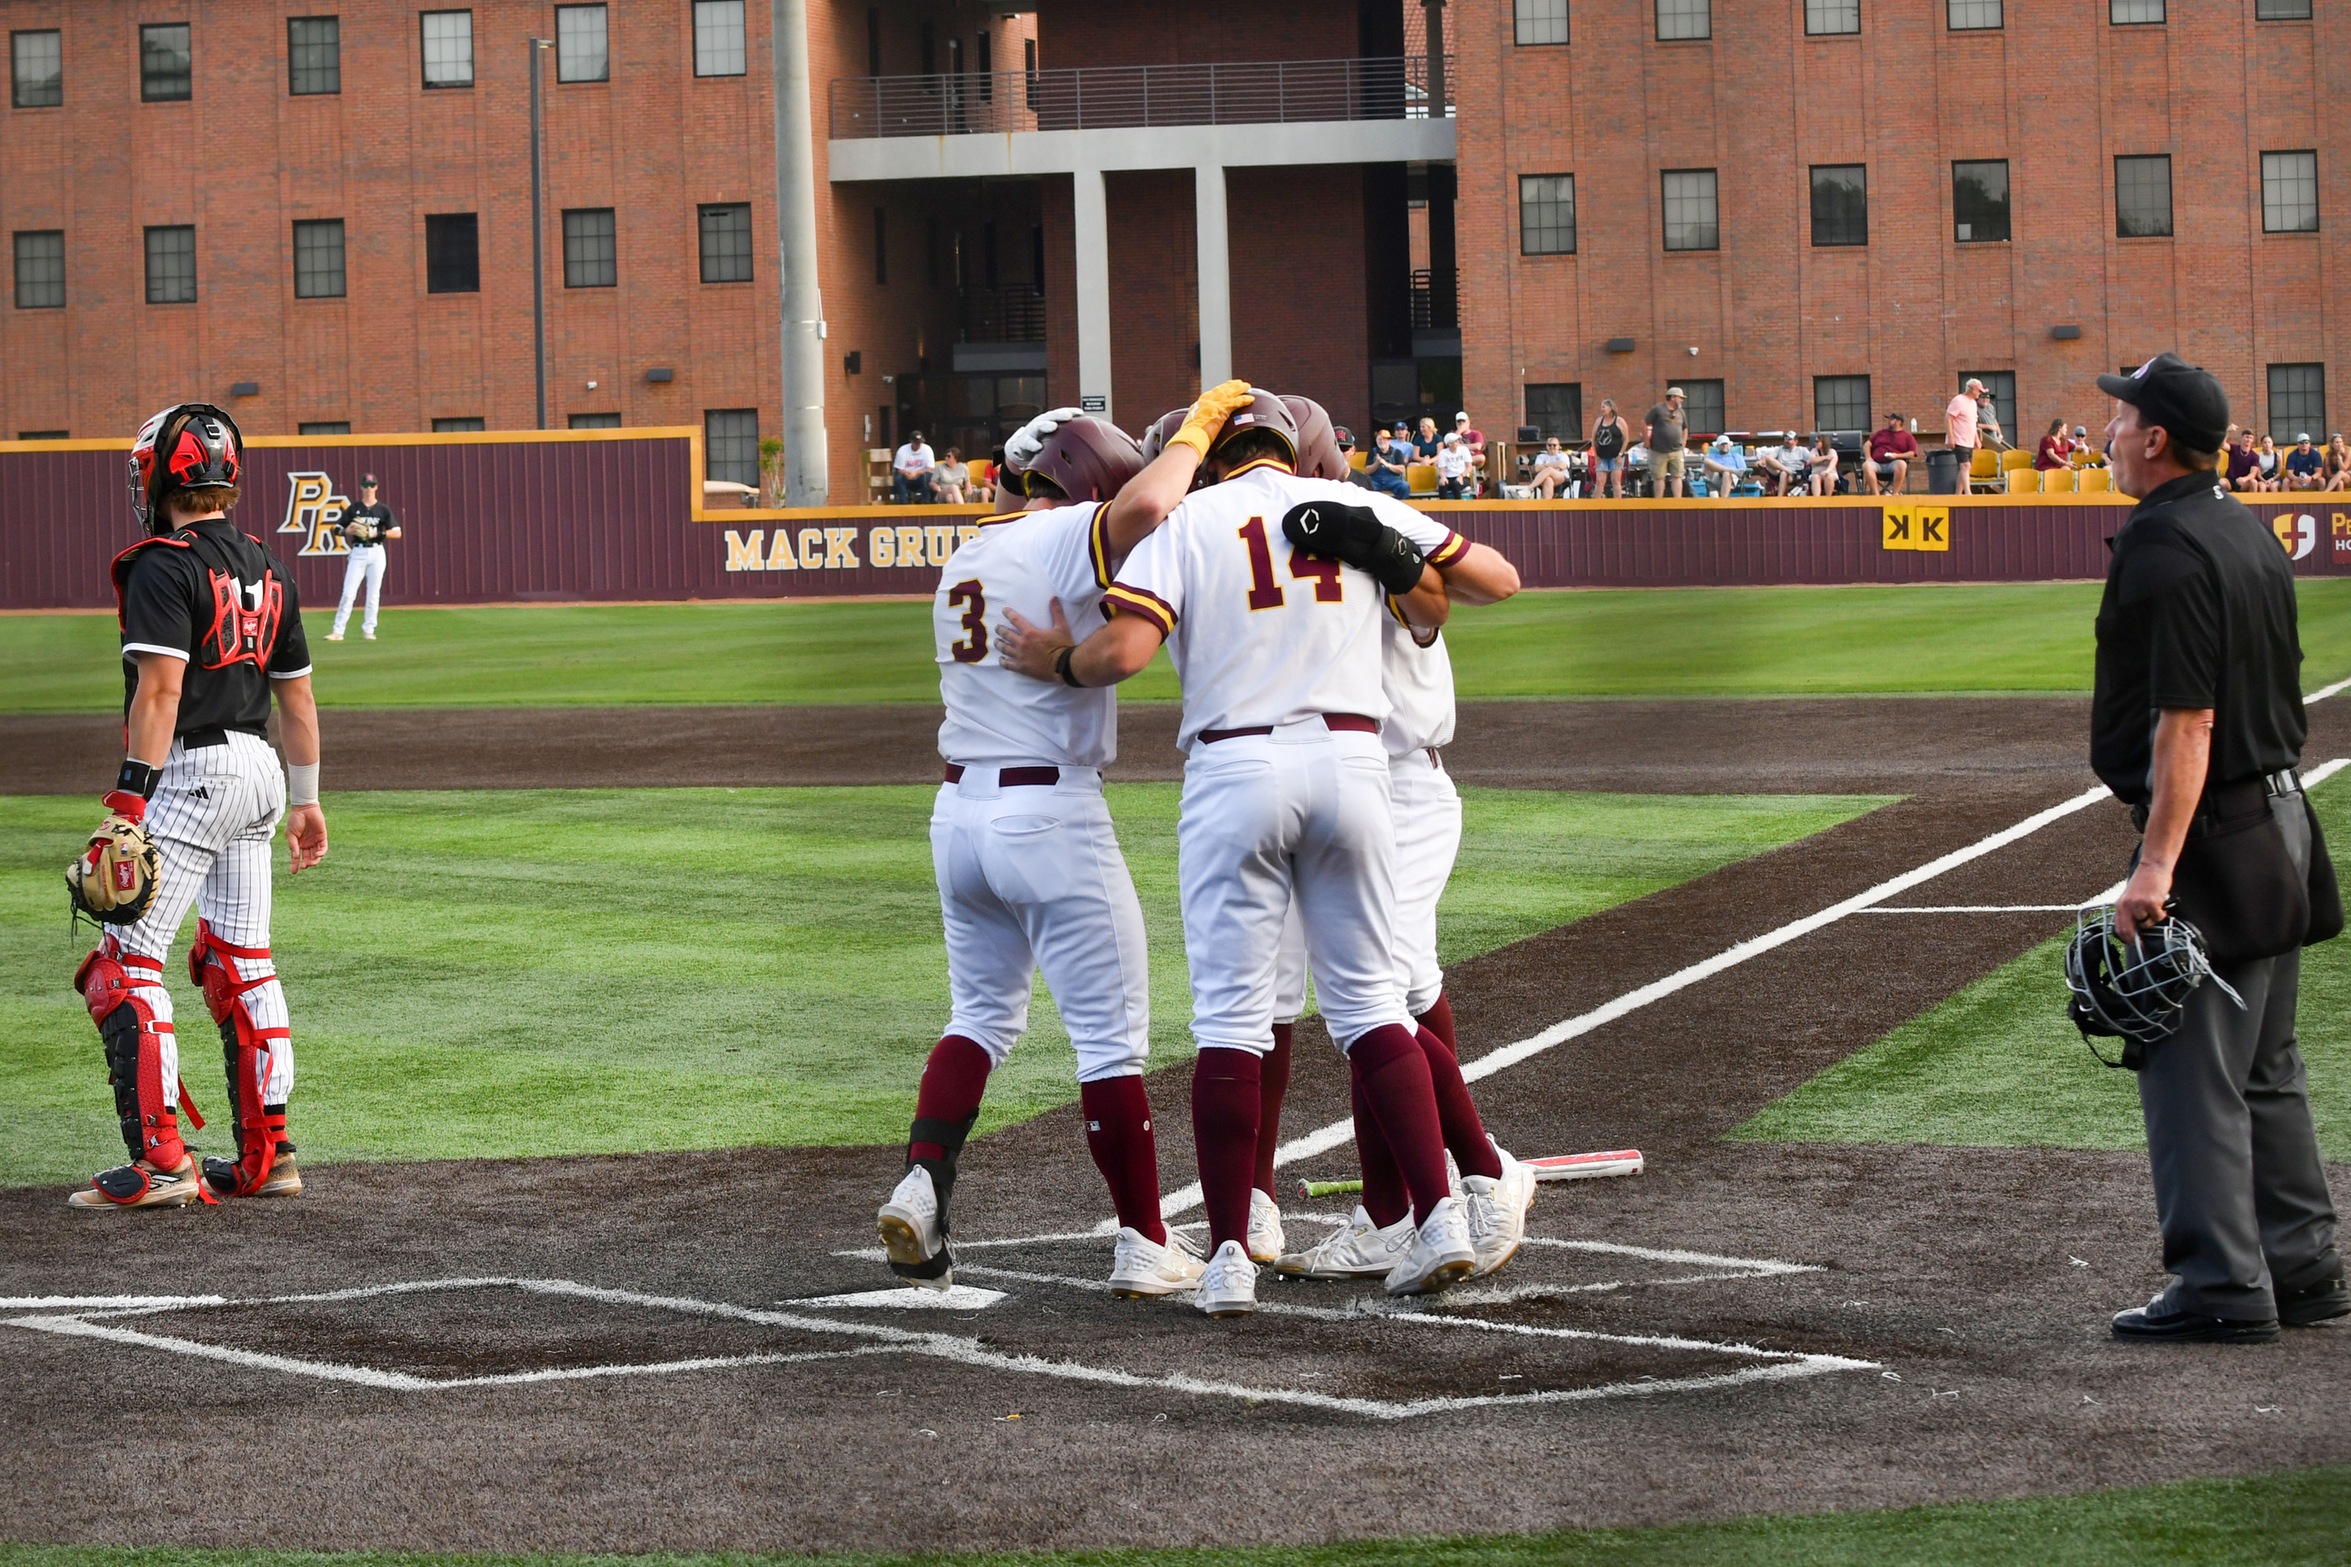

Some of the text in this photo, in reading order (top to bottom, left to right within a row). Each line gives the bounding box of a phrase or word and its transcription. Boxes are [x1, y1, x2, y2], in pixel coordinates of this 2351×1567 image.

[724, 527, 860, 572] MACK
[1923, 517, 1944, 542] K
[1237, 516, 1343, 613] 14
[948, 576, 989, 665] 3
